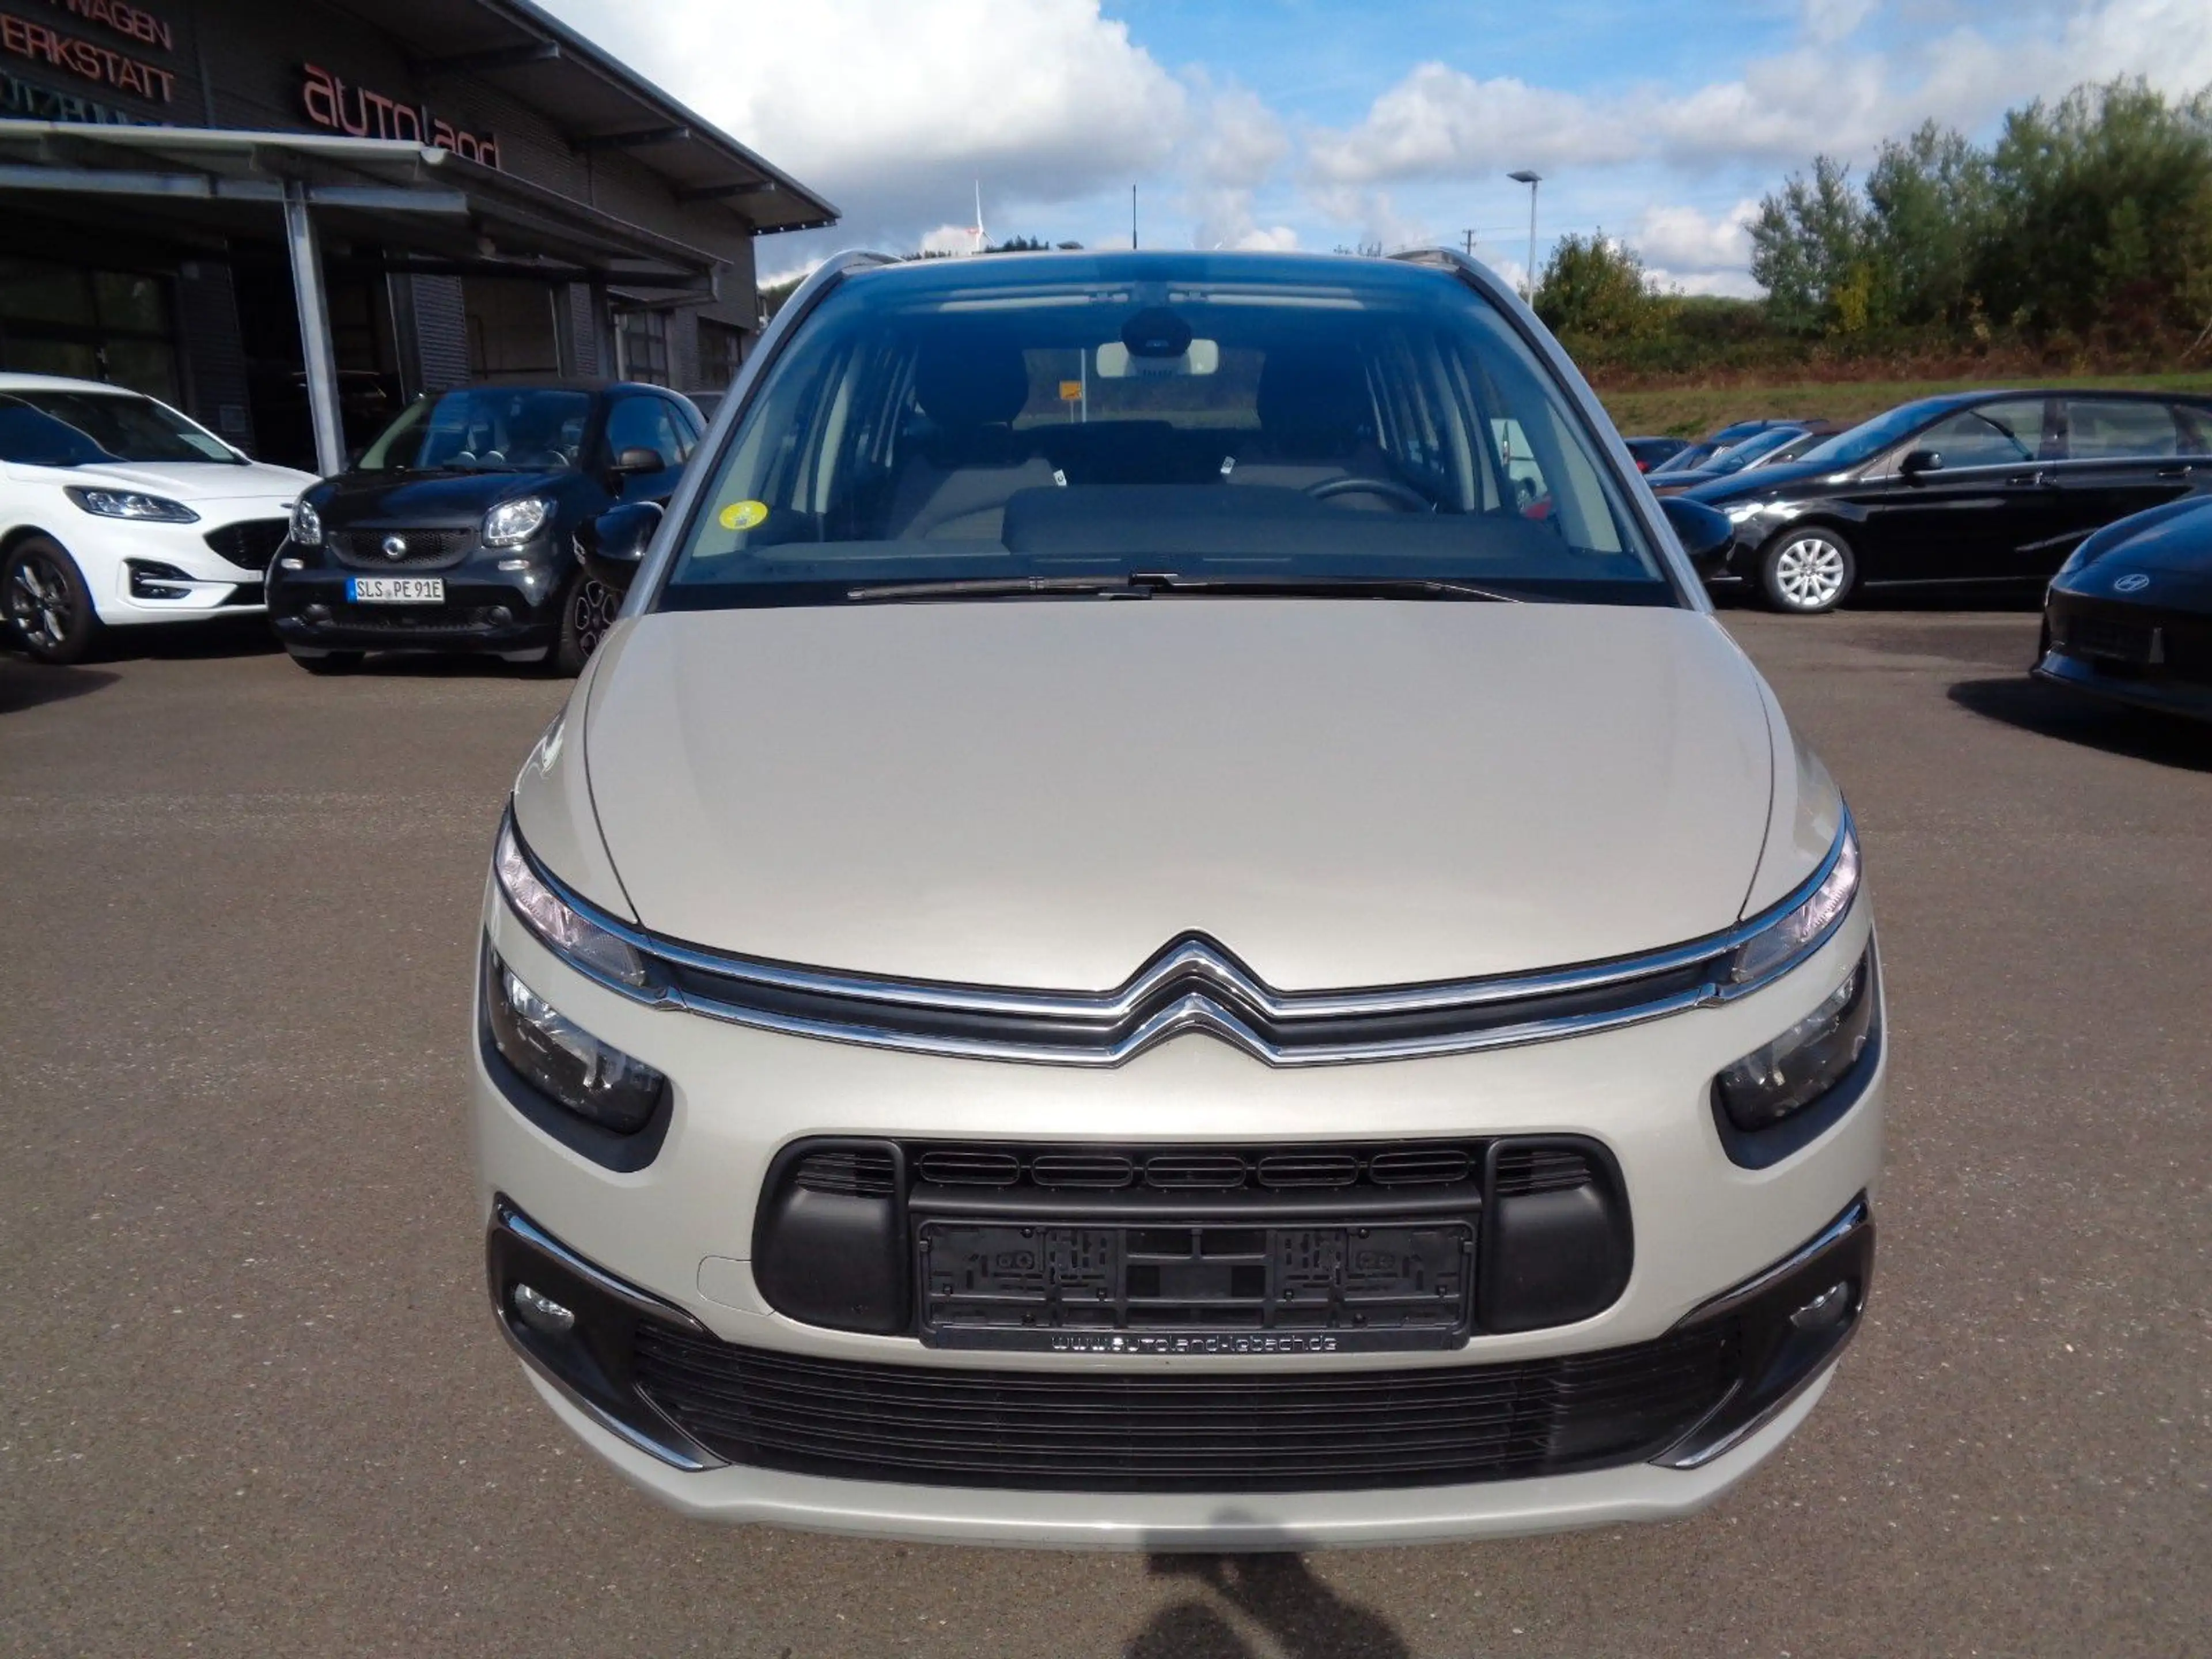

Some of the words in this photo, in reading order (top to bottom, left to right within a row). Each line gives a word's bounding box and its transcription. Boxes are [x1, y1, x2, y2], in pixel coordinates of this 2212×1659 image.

[357, 580, 383, 597] SLS
[393, 580, 411, 598] PE
[414, 581, 441, 598] 91E
